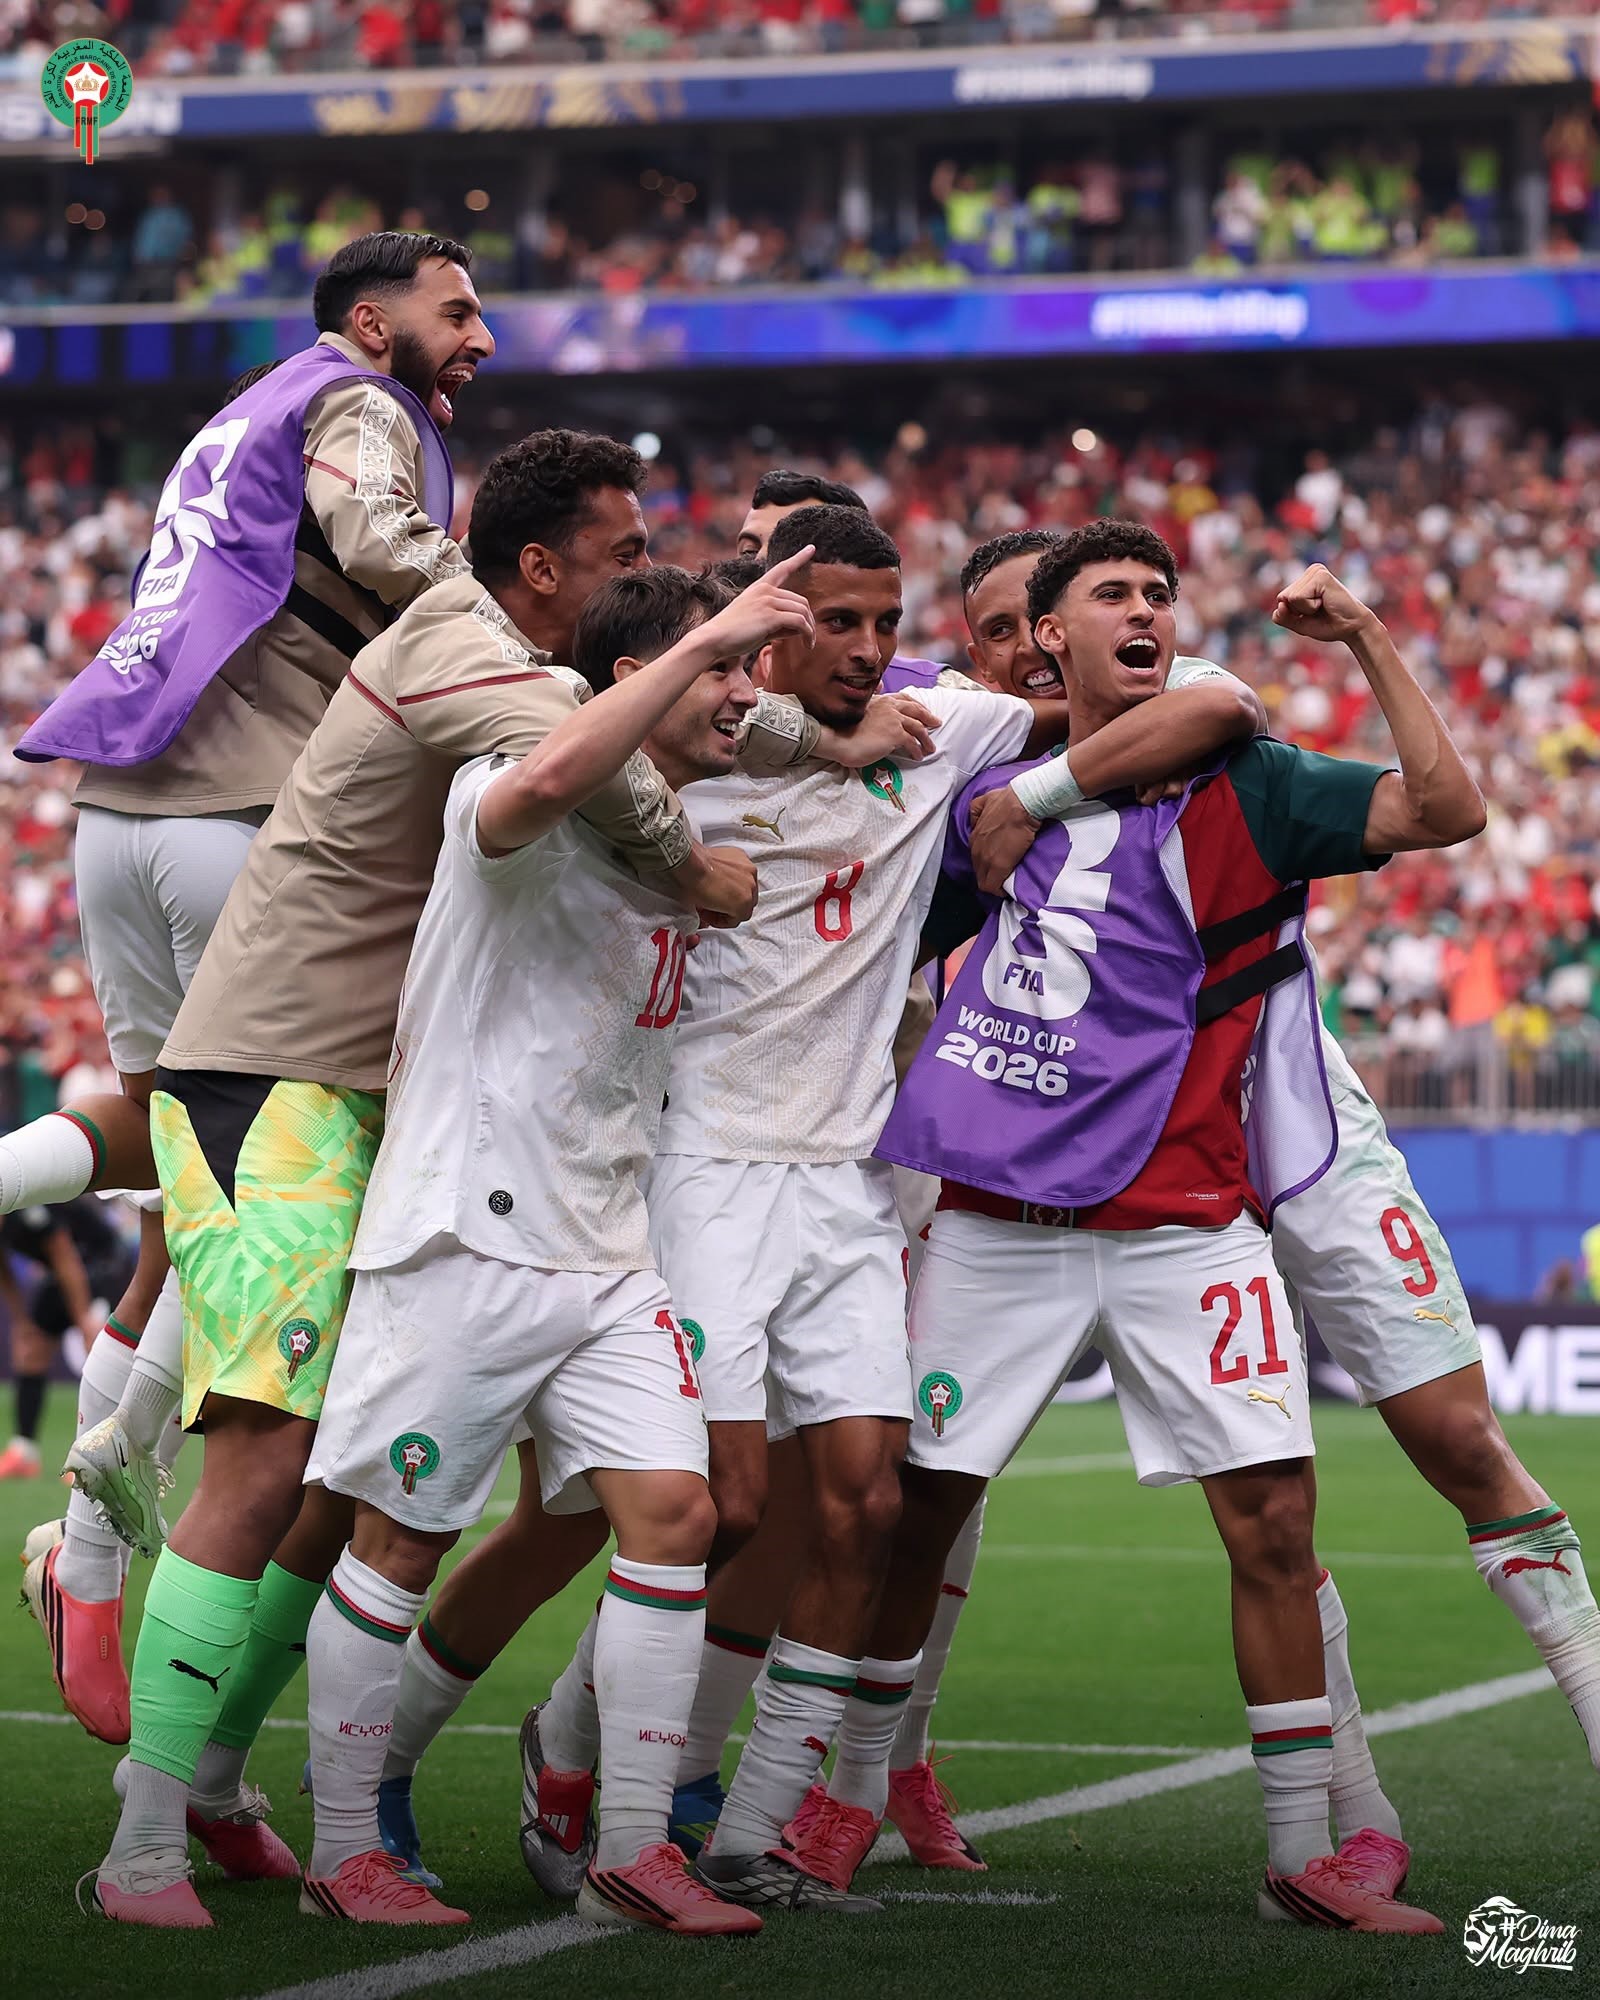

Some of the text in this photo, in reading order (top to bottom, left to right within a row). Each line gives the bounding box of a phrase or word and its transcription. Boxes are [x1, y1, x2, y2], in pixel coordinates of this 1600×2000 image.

[138, 572, 180, 597] FIFA
[140, 608, 179, 628] CUP
[814, 860, 865, 942] 8
[634, 927, 687, 1030] 10
[935, 1032, 1069, 1097] 2026
[957, 1005, 1077, 1057] WORLD CUP
[1379, 1206, 1438, 1298] 9
[1200, 1276, 1289, 1385] 21
